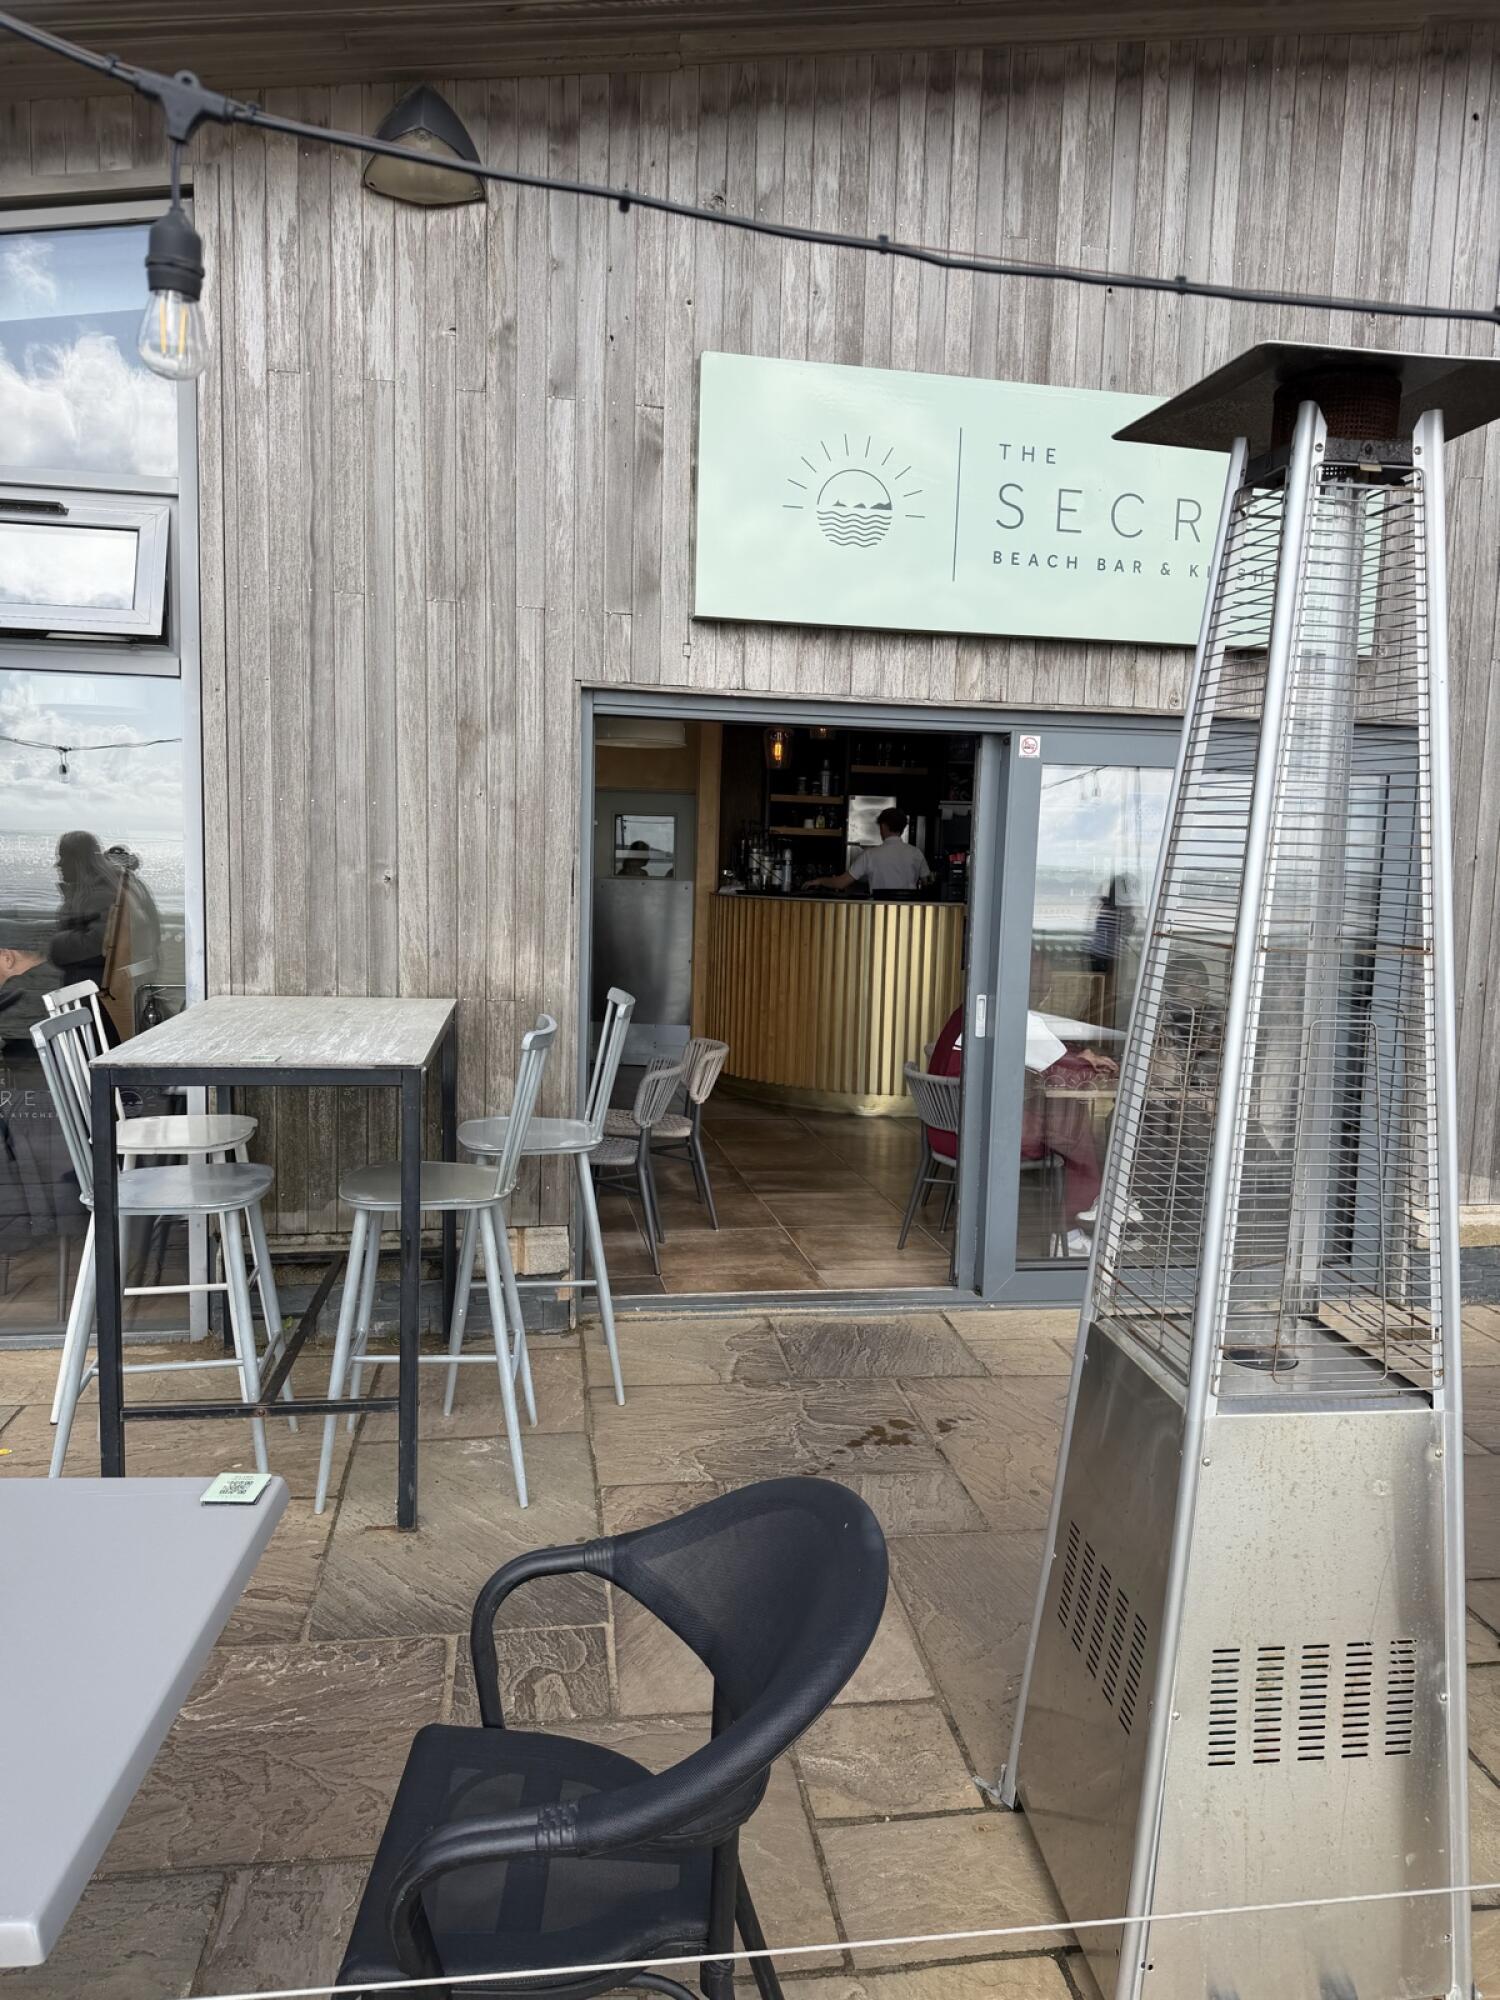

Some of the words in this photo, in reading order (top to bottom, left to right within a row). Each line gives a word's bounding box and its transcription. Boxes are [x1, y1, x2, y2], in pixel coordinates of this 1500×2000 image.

[999, 443, 1056, 465] THE
[996, 482, 1258, 543] SECR
[993, 550, 1078, 570] BEACH
[1097, 557, 1142, 574] BAR
[1160, 562, 1171, 576] &
